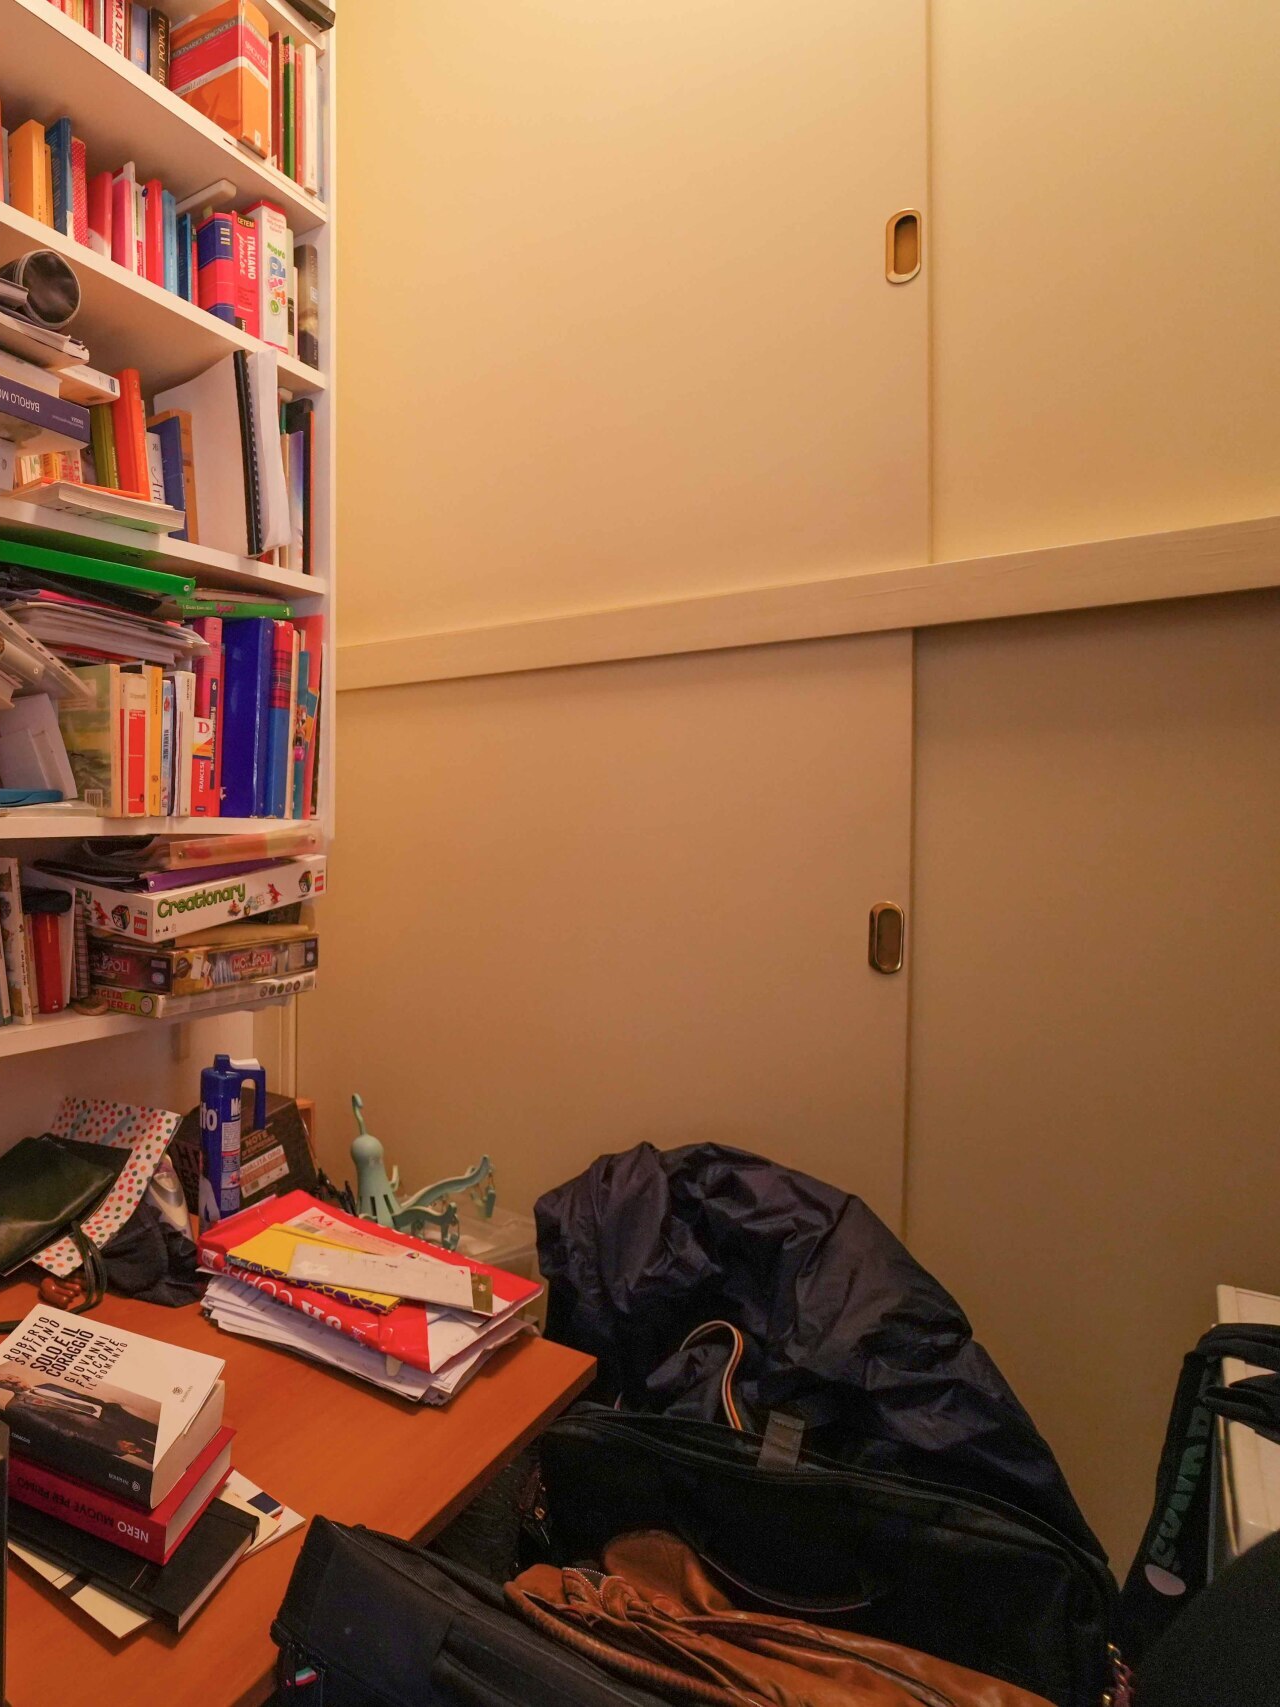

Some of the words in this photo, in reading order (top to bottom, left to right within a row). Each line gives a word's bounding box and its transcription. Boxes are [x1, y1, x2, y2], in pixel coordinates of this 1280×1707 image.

[158, 17, 167, 61] POPOLI
[237, 216, 256, 231] CETEM
[247, 236, 257, 280] ITALIANO
[9, 393, 40, 413] BAROLO
[197, 720, 210, 734] D
[197, 760, 206, 793] FRANCESE
[156, 881, 247, 920] Creationary
[2, 1316, 50, 1361] ROBERTO
[14, 1319, 60, 1365] SAVIANO
[50, 1335, 71, 1348] È
[59, 1326, 82, 1339] IL
[29, 1345, 64, 1372] SOLO
[45, 1329, 95, 1378] CORAGGIO
[63, 1335, 110, 1384] GIOVANNI
[74, 1338, 120, 1388] FALCONE
[85, 1382, 98, 1391] IL
[95, 1342, 129, 1380] ROMANZO
[16, 1476, 50, 1500] PRIMO
[51, 1491, 71, 1509] PER
[73, 1501, 115, 1528] MUOVE
[117, 1520, 150, 1544] NERO
